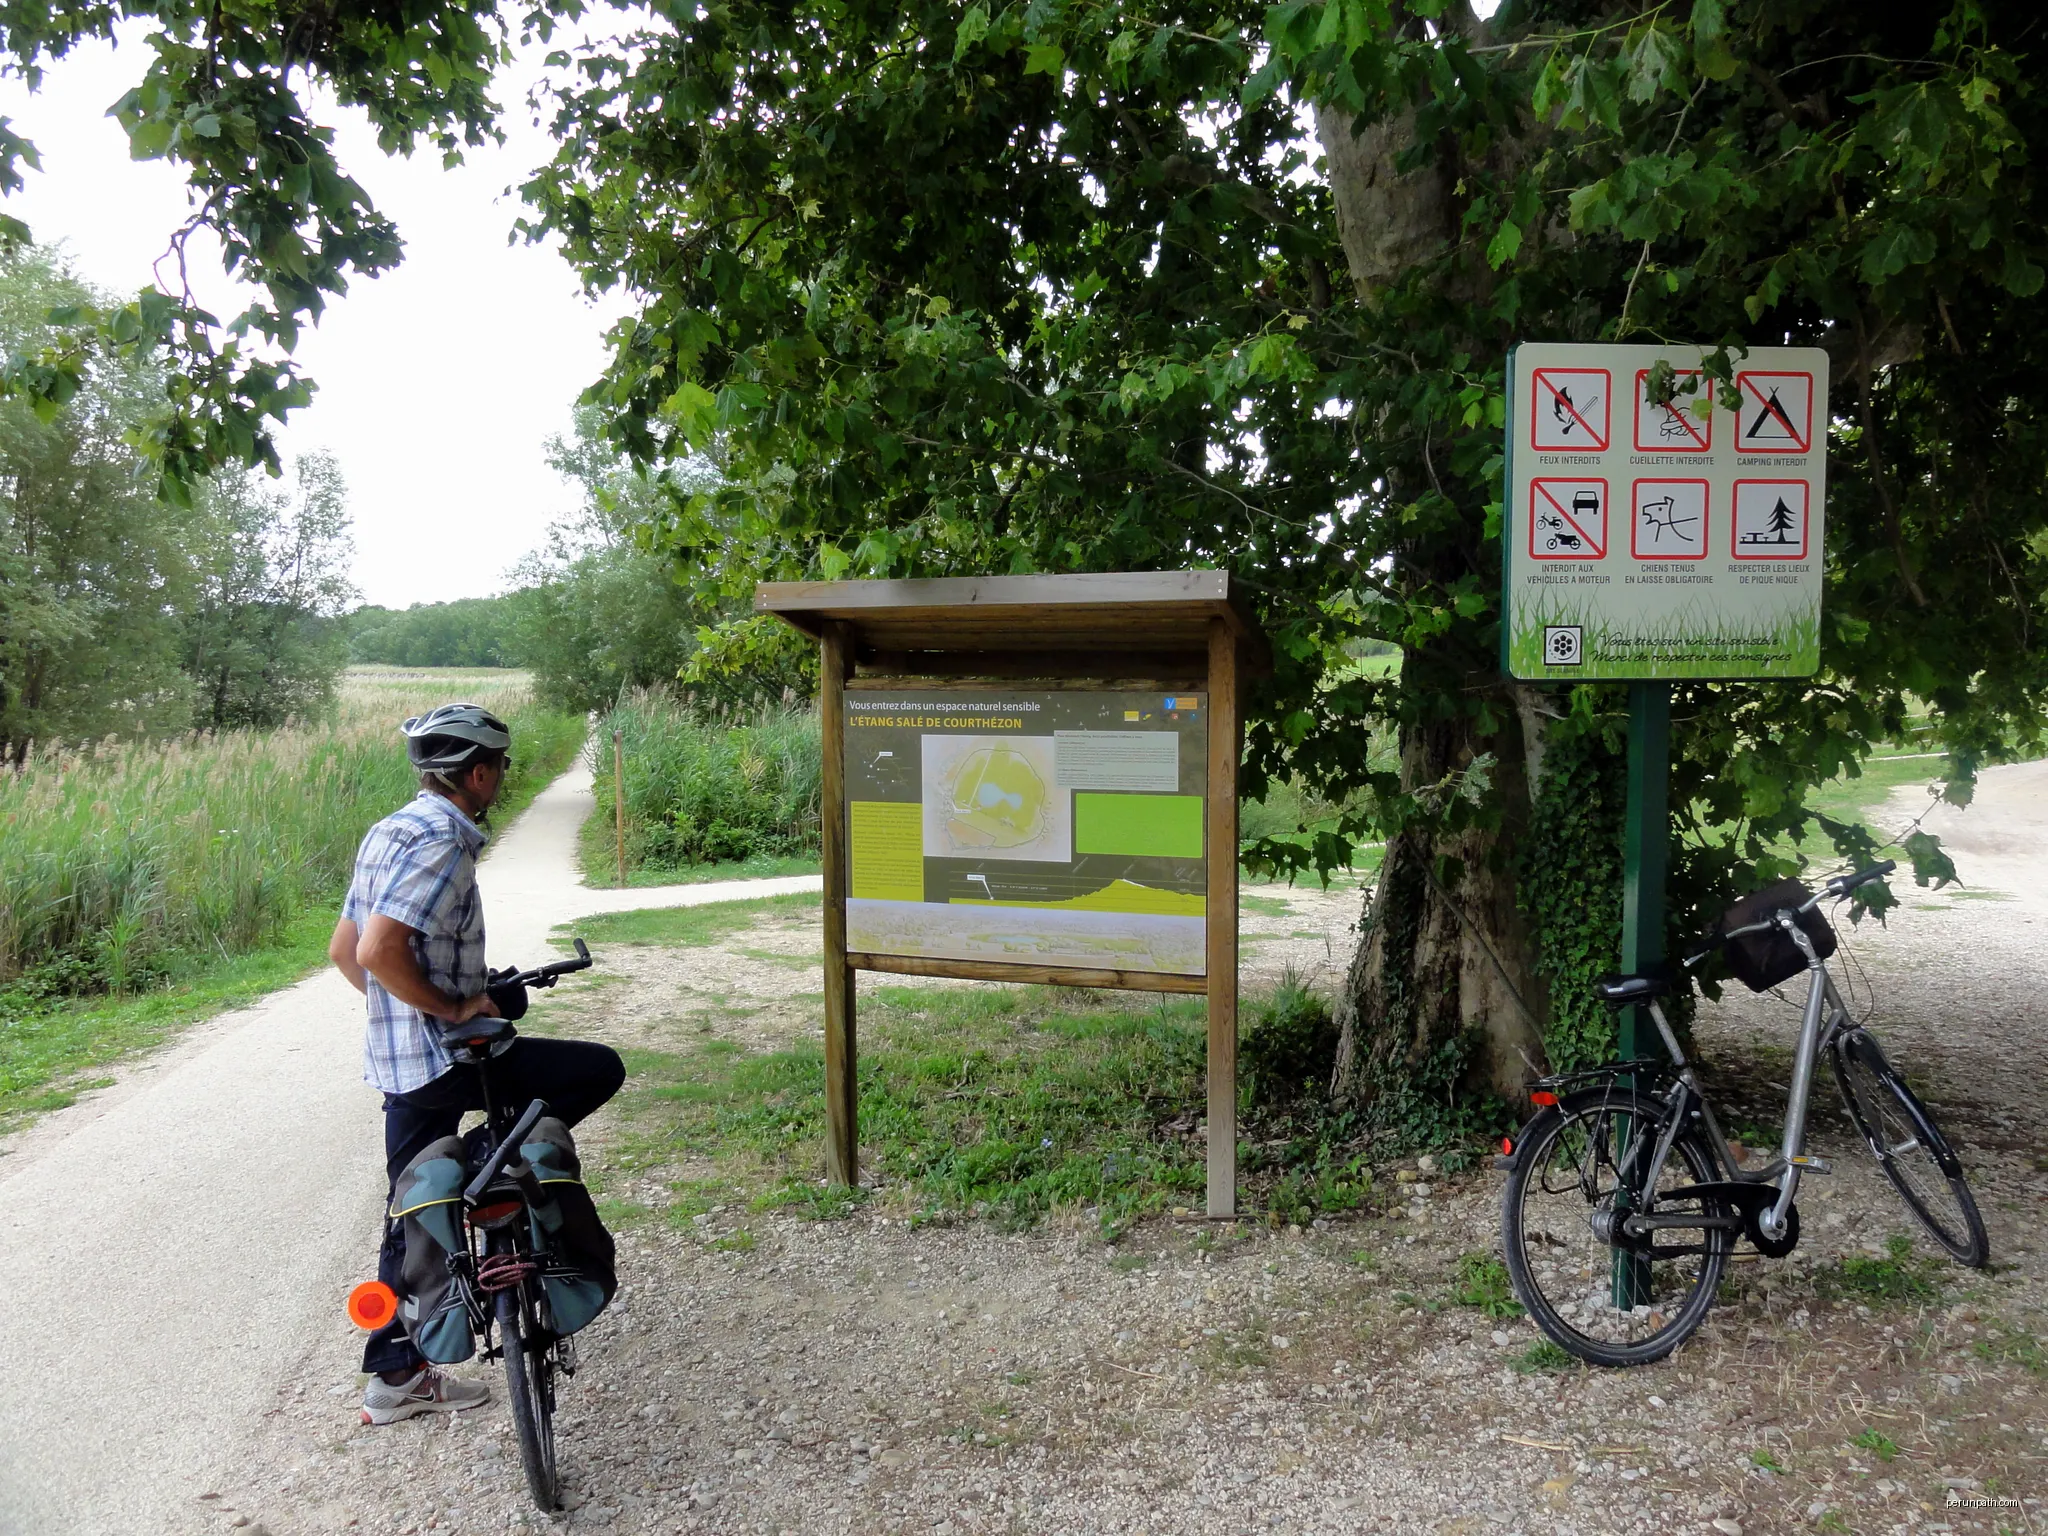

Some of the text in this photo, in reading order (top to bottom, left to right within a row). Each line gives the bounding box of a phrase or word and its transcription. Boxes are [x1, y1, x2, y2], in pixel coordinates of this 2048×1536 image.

[1539, 455, 1601, 465] FEUX INTERDITS
[1629, 456, 1715, 465] CUEILLETTE INTERDITE
[1737, 457, 1807, 466] CAMPING INTERDIT
[1541, 564, 1594, 573] INTERDIT AUX
[1640, 564, 1696, 573] CHIENS TENUS
[1728, 564, 1810, 573] RESPECTER LES LIEUX
[1578, 575, 1611, 584] MOTEUR
[1624, 575, 1714, 584] EN LAISSE OBLIGATOIRE
[1739, 575, 1798, 585] DE PIQUE NIQUE
[1600, 632, 1633, 646] Vous
[1660, 638, 1683, 646] sur
[1705, 637, 1727, 645] site
[1729, 636, 1779, 645] sensible
[1589, 650, 1793, 667] Merci de respecter ces consignes
[849, 700, 871, 710] Vous
[871, 701, 900, 710] entrez
[900, 700, 922, 710] dans
[935, 702, 968, 713] espace
[968, 701, 1001, 711] naturel
[1002, 702, 1041, 711] sensible
[896, 716, 924, 728] SALÉ
[926, 717, 941, 728] DE
[943, 717, 1023, 729] COURTHÉZON
